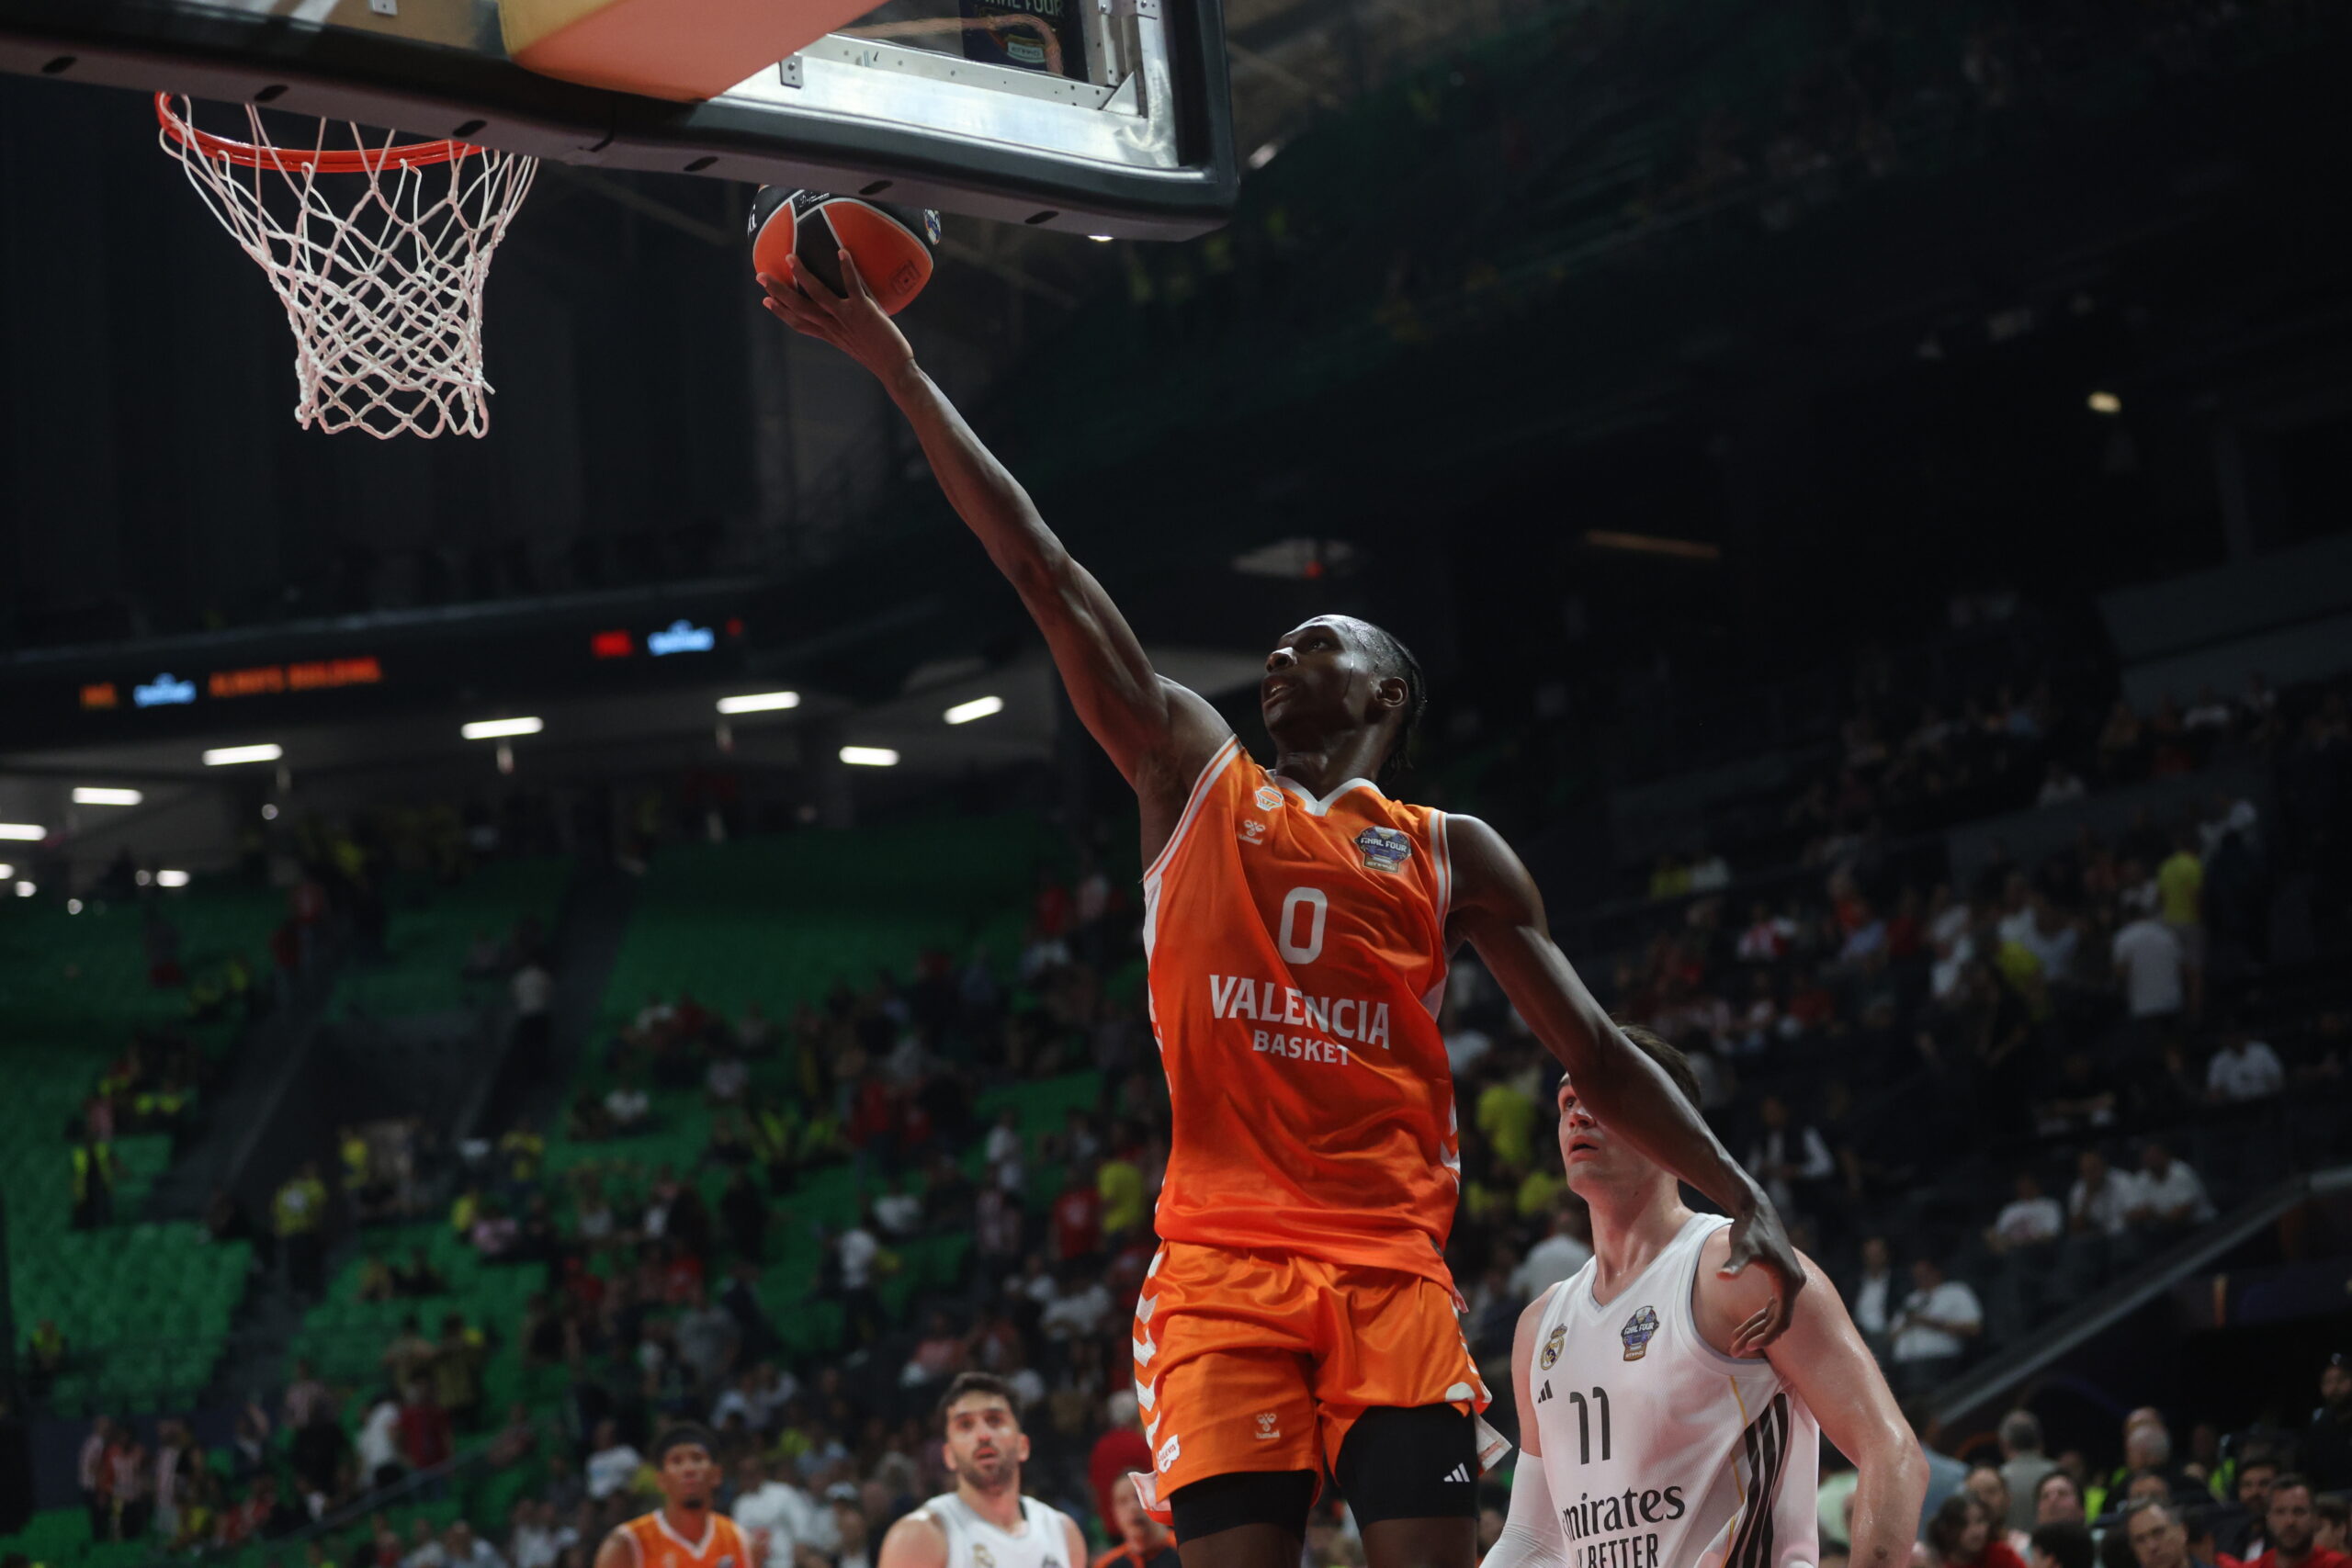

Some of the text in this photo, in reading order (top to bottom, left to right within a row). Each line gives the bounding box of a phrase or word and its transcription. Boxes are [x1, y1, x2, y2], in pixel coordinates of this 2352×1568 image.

[1361, 837, 1384, 847] FINAL
[1385, 840, 1408, 852] FOUR
[1279, 886, 1328, 964] 0
[1209, 974, 1390, 1050] VALENCIA
[1252, 1029, 1351, 1066] BASKET
[1639, 1322, 1655, 1331] FOUR
[1569, 1387, 1611, 1465] 11
[1563, 1485, 1685, 1541] mirates
[1588, 1533, 1658, 1568] BETTER
